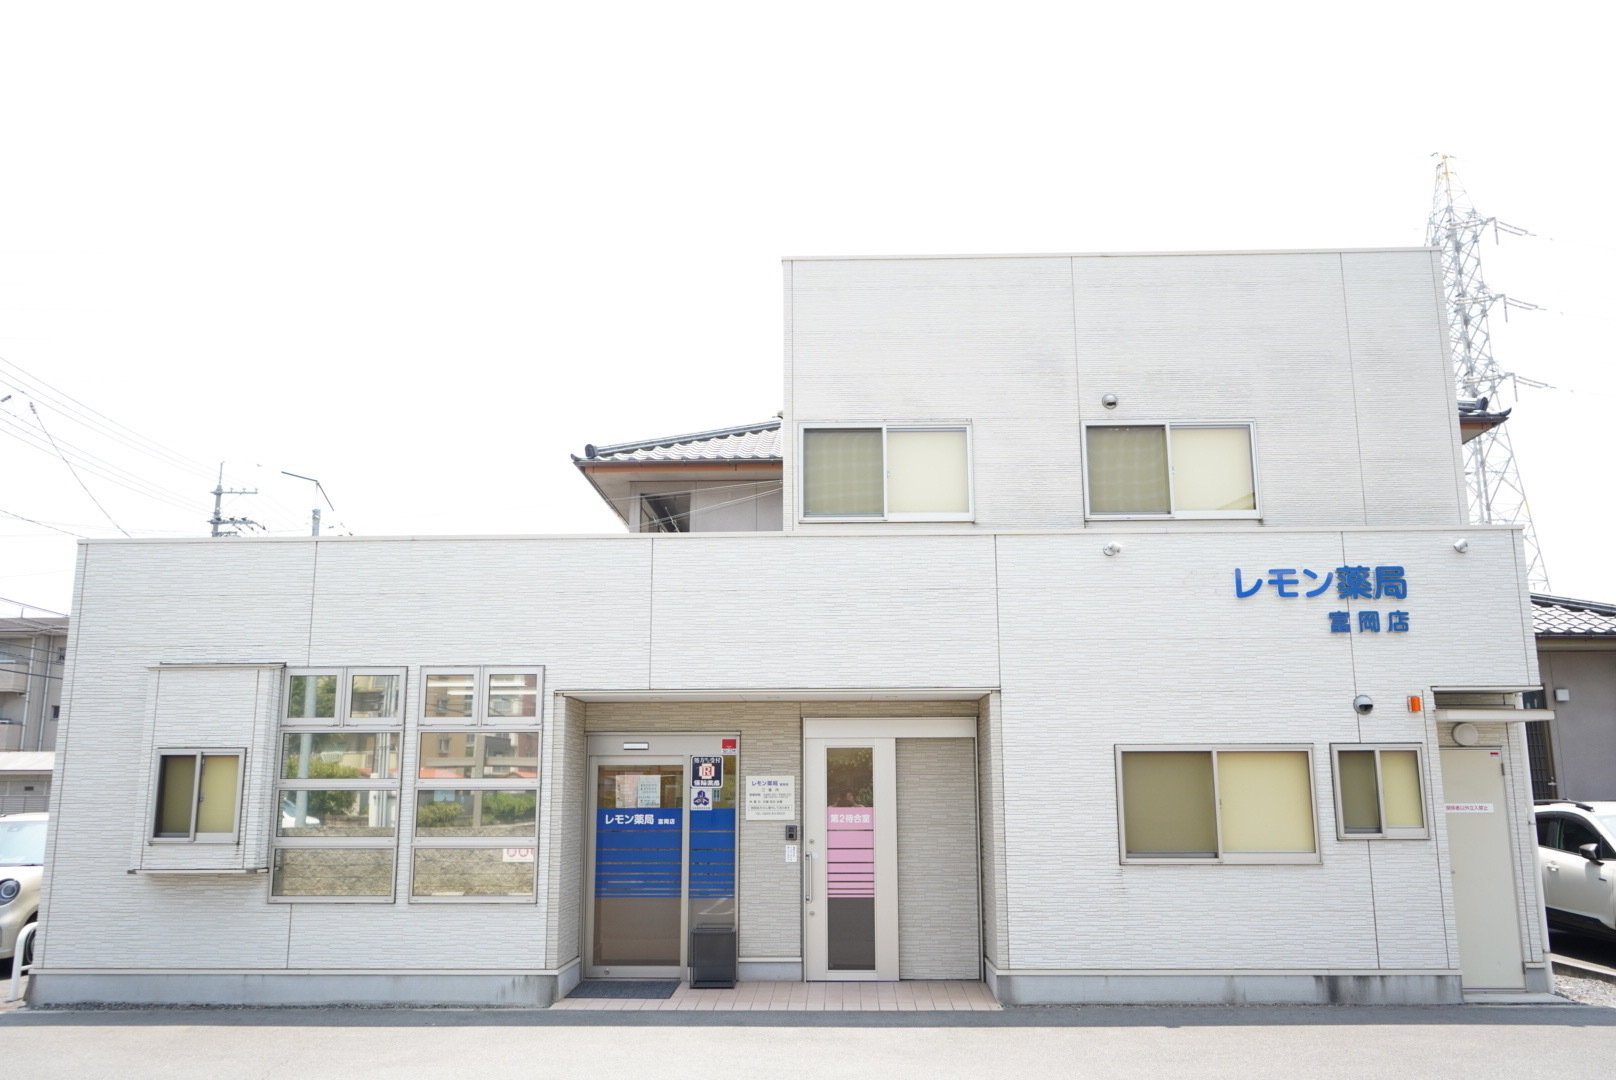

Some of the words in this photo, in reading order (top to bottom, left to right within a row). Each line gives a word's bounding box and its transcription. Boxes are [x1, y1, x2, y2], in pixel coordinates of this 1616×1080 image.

[1235, 565, 1407, 599] レモン薬局
[1328, 610, 1410, 633] 富岡店
[605, 814, 654, 825] レモン薬局
[830, 814, 870, 823] 第2待合室
